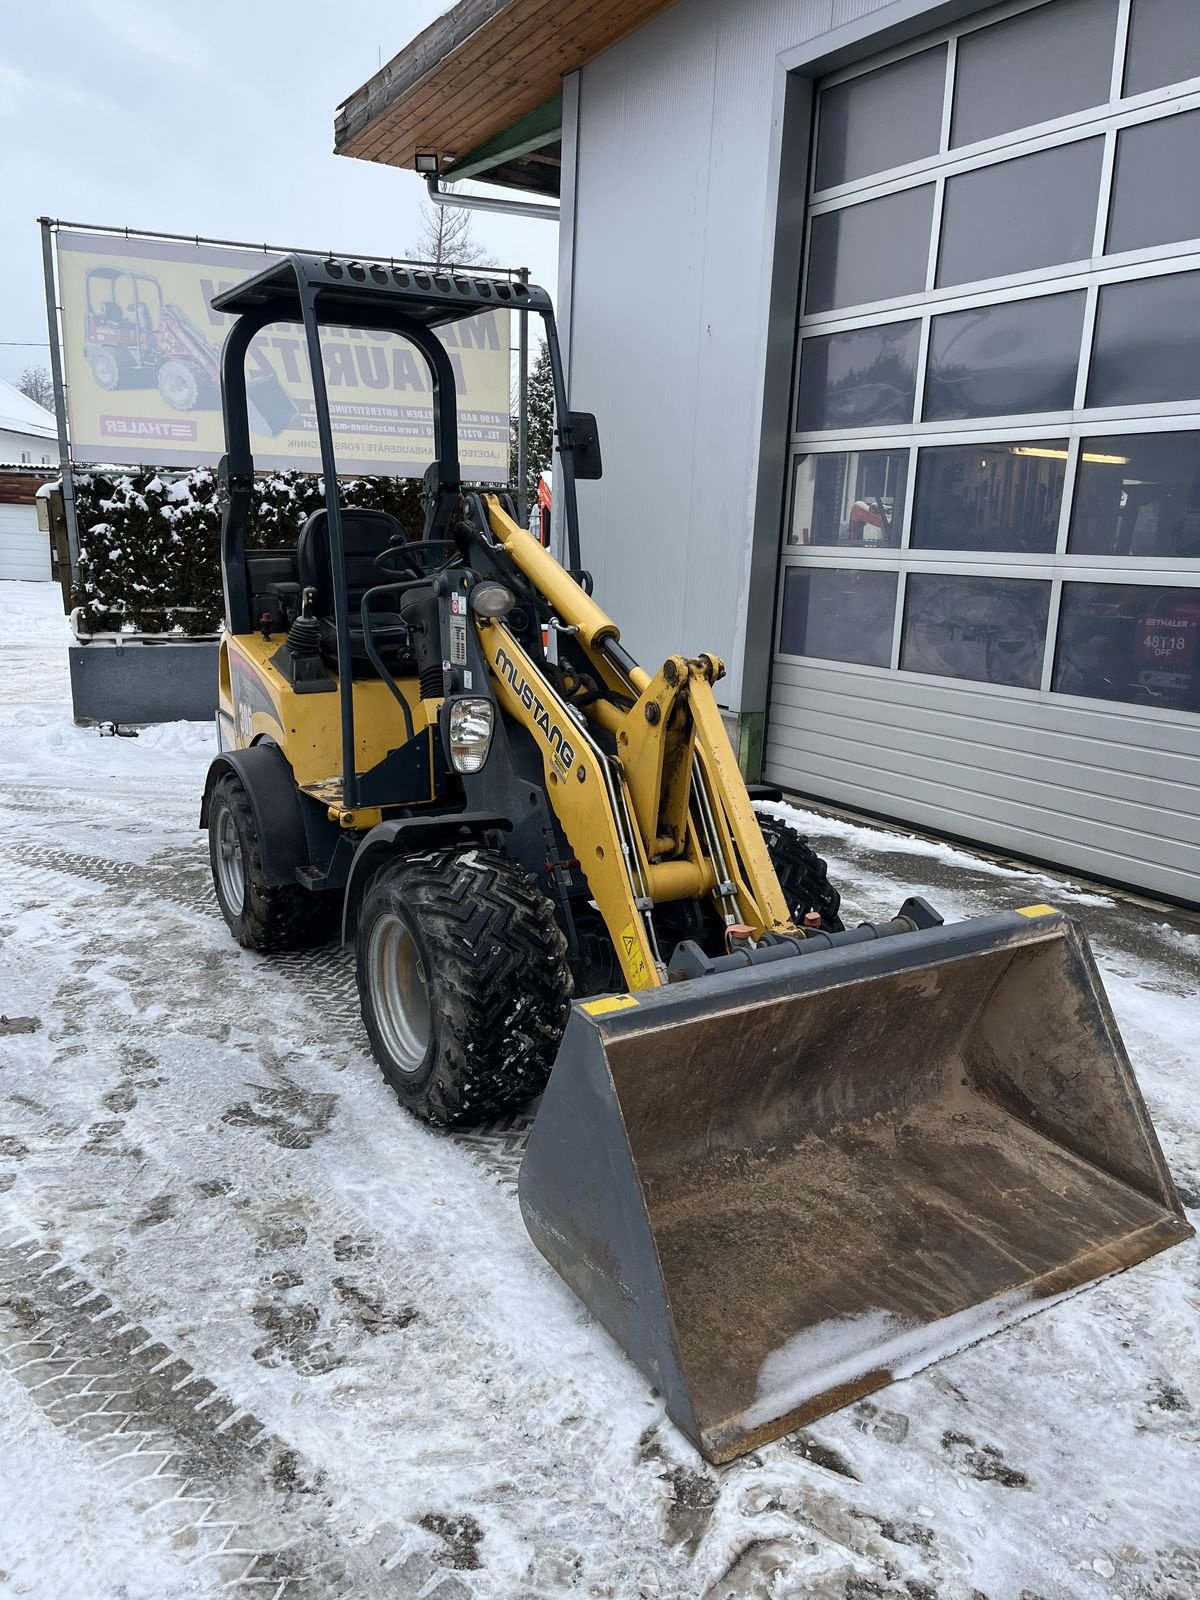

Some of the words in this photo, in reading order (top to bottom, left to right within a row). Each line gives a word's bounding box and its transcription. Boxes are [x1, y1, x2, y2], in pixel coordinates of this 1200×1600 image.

[1143, 635, 1185, 650] 48T18
[1154, 648, 1172, 656] DPF
[494, 647, 577, 770] MUSTANG
